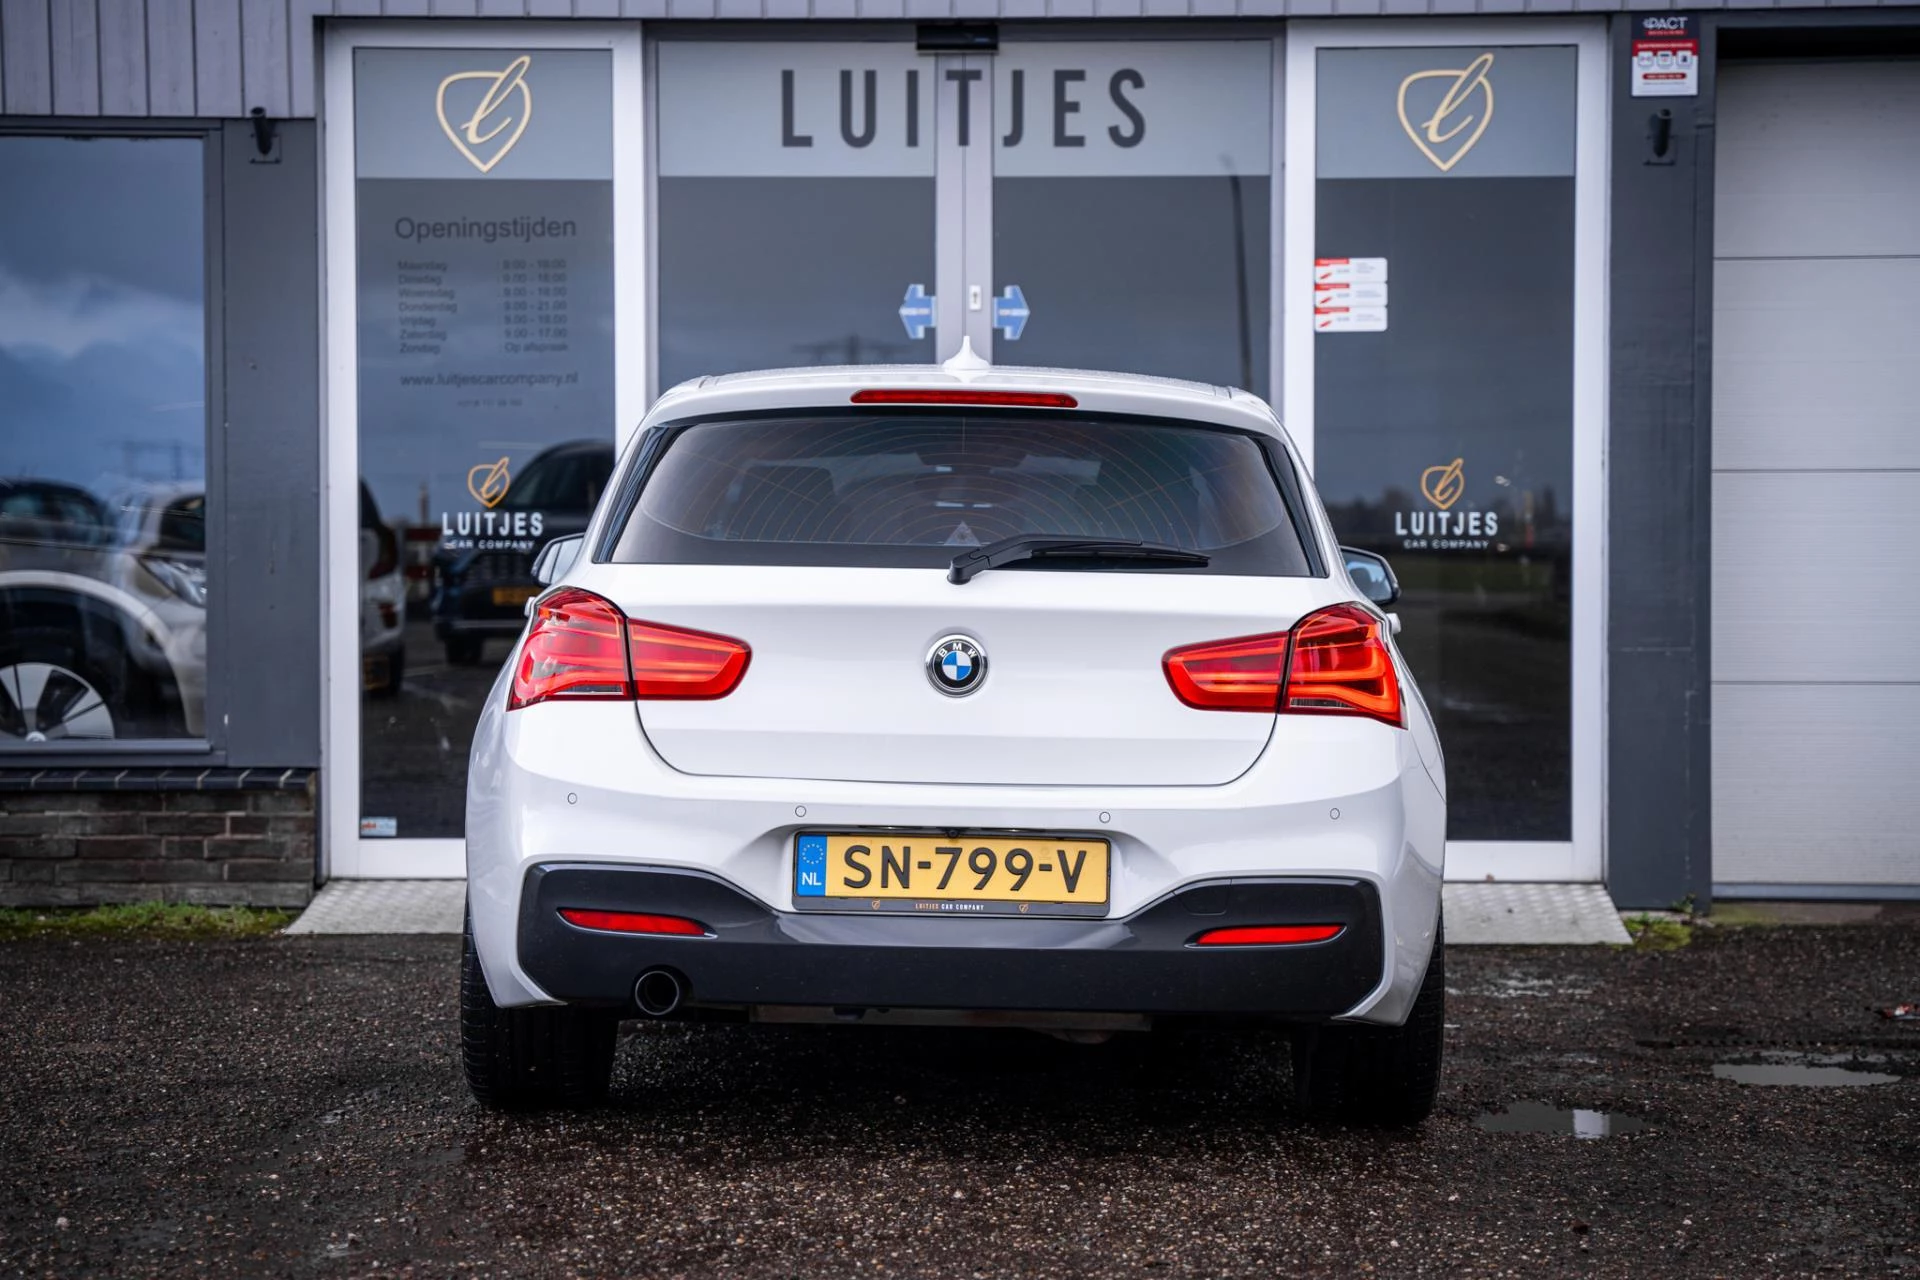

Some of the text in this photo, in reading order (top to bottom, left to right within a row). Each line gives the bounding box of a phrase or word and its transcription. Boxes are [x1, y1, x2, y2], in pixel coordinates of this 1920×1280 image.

[781, 69, 1146, 148] LUITJES
[395, 217, 576, 243] Openingstijden
[442, 512, 543, 536] LUITJES
[1395, 512, 1498, 536] LUITJES
[451, 540, 534, 550] CAR COMPANY
[1403, 540, 1488, 549] CAR COMPANY
[938, 643, 977, 658] BMW
[802, 872, 822, 886] NL
[843, 845, 1087, 893] SN-799-V
